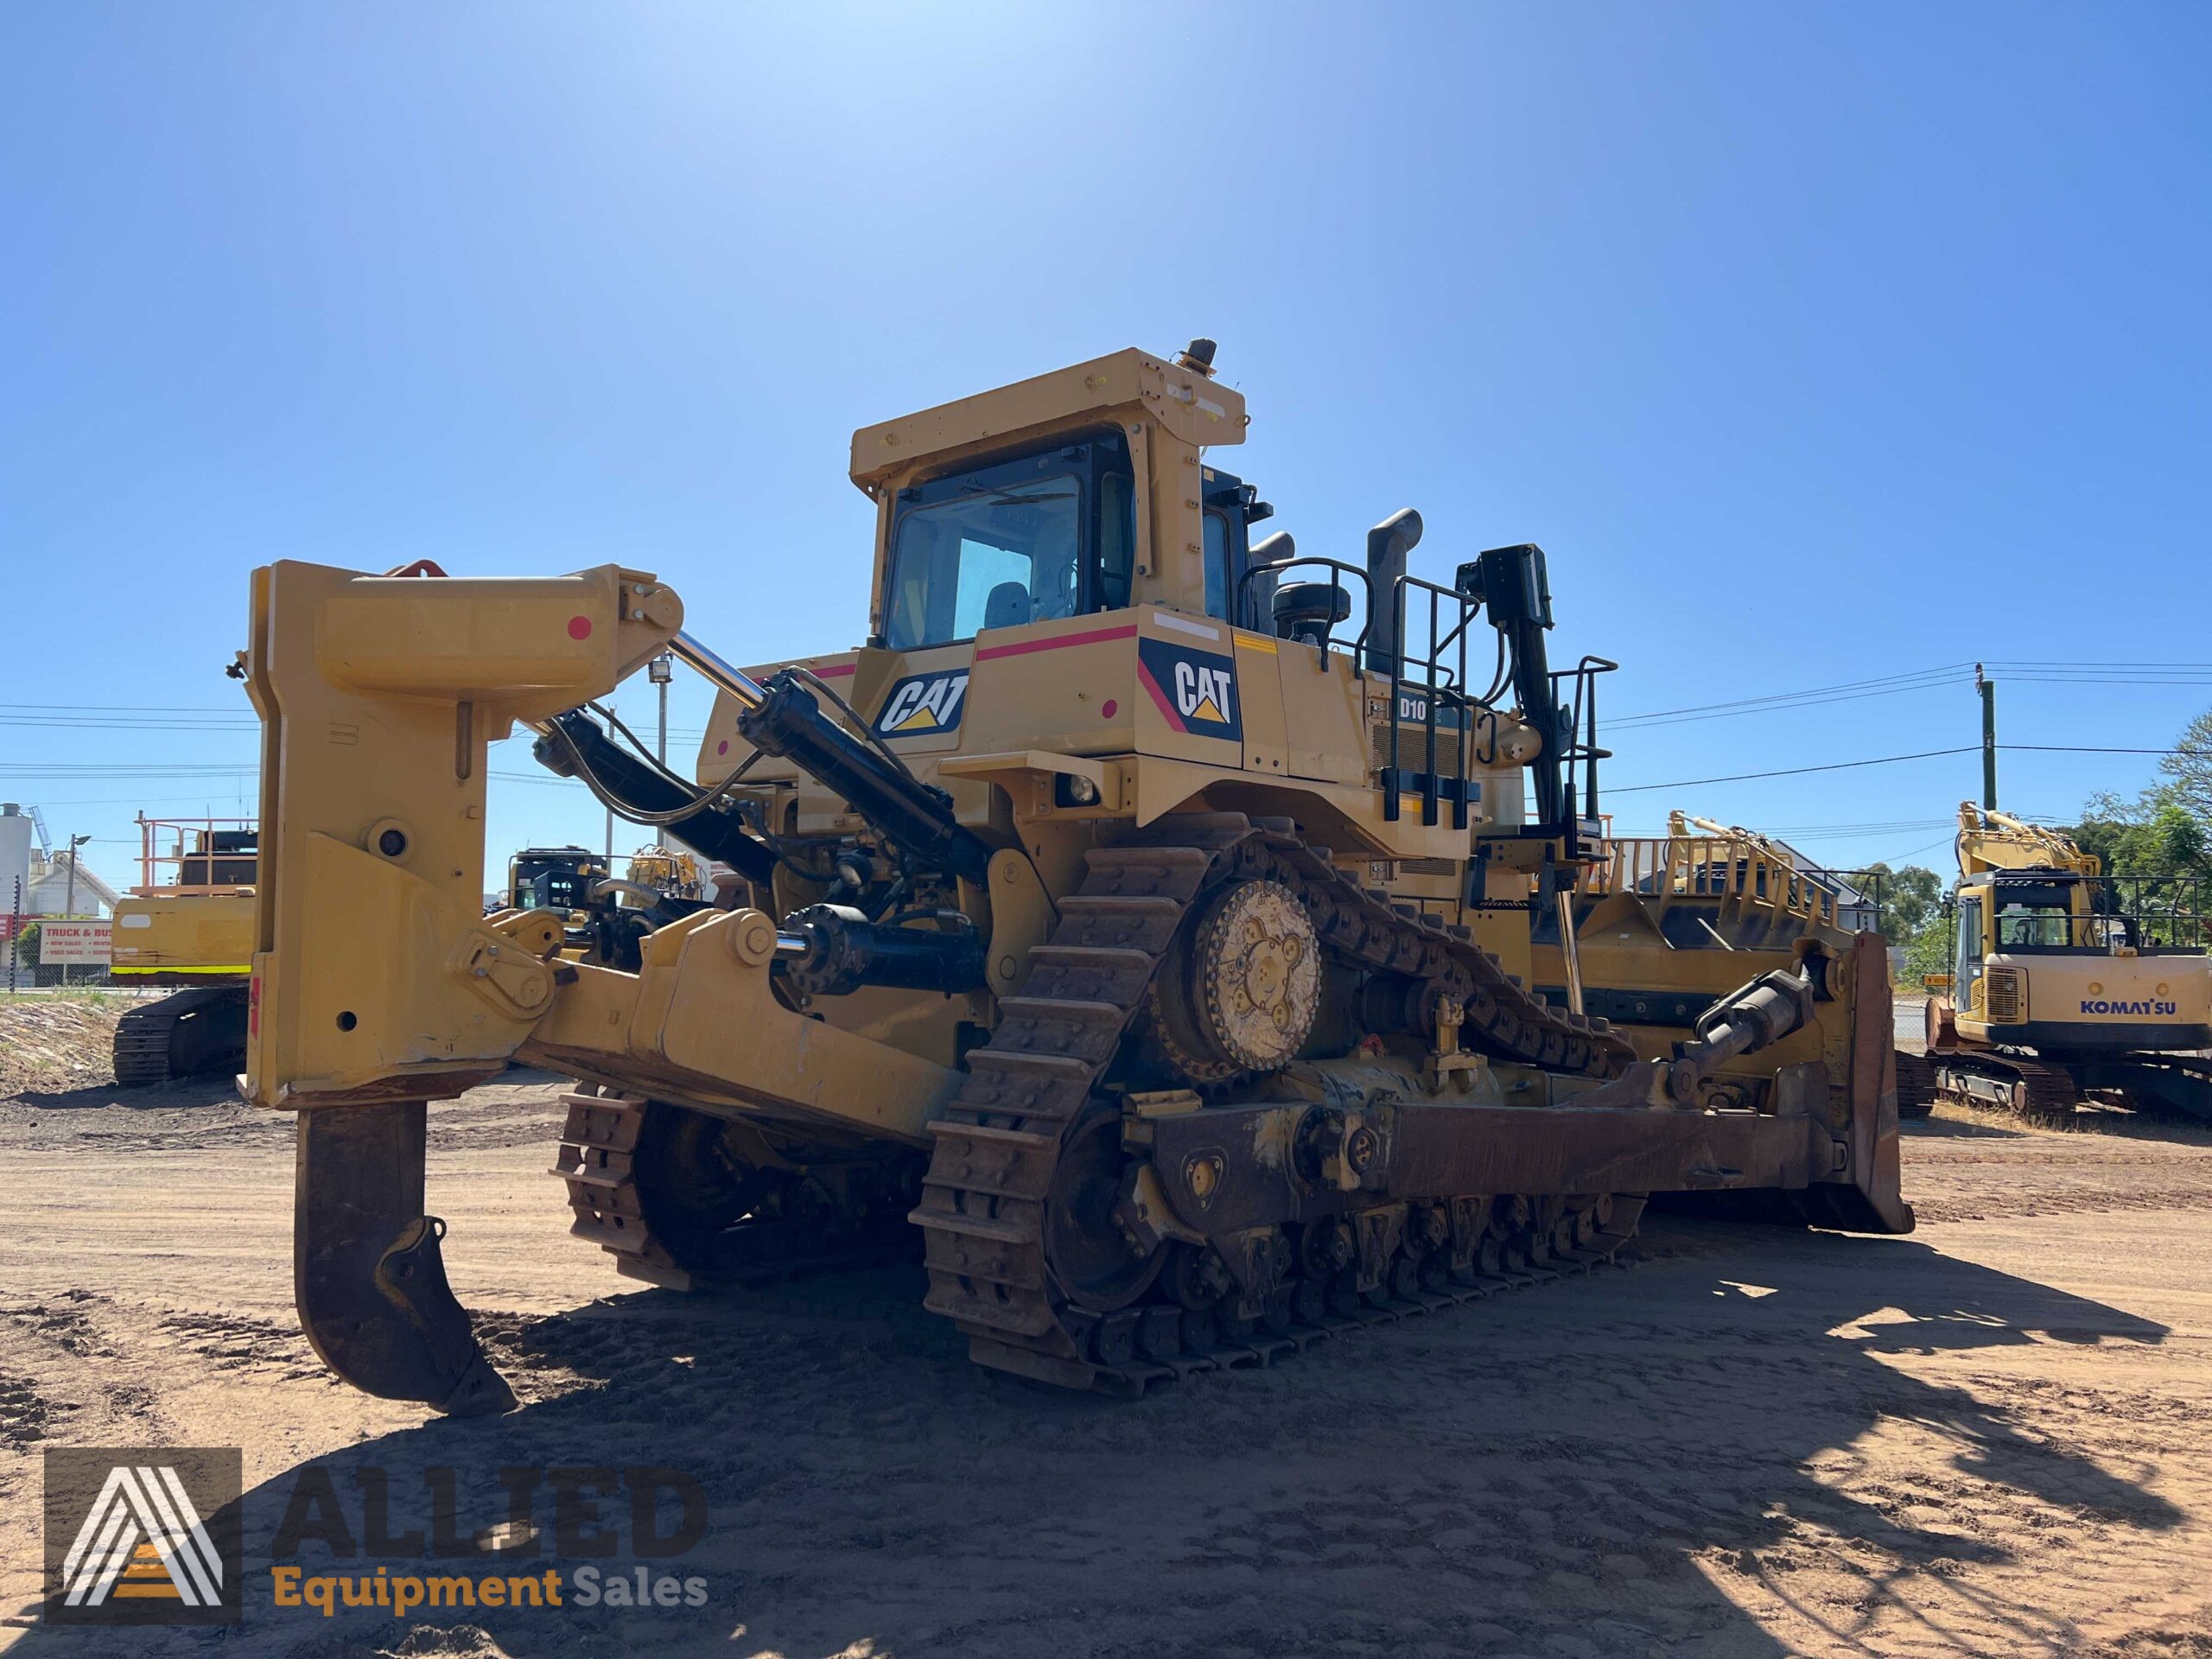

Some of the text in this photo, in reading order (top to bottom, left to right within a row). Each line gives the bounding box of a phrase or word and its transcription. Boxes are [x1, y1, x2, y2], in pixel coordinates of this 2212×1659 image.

[880, 675, 969, 732] CAT
[1175, 662, 1231, 724] CAT
[2080, 998, 2176, 1015] KOMATSU
